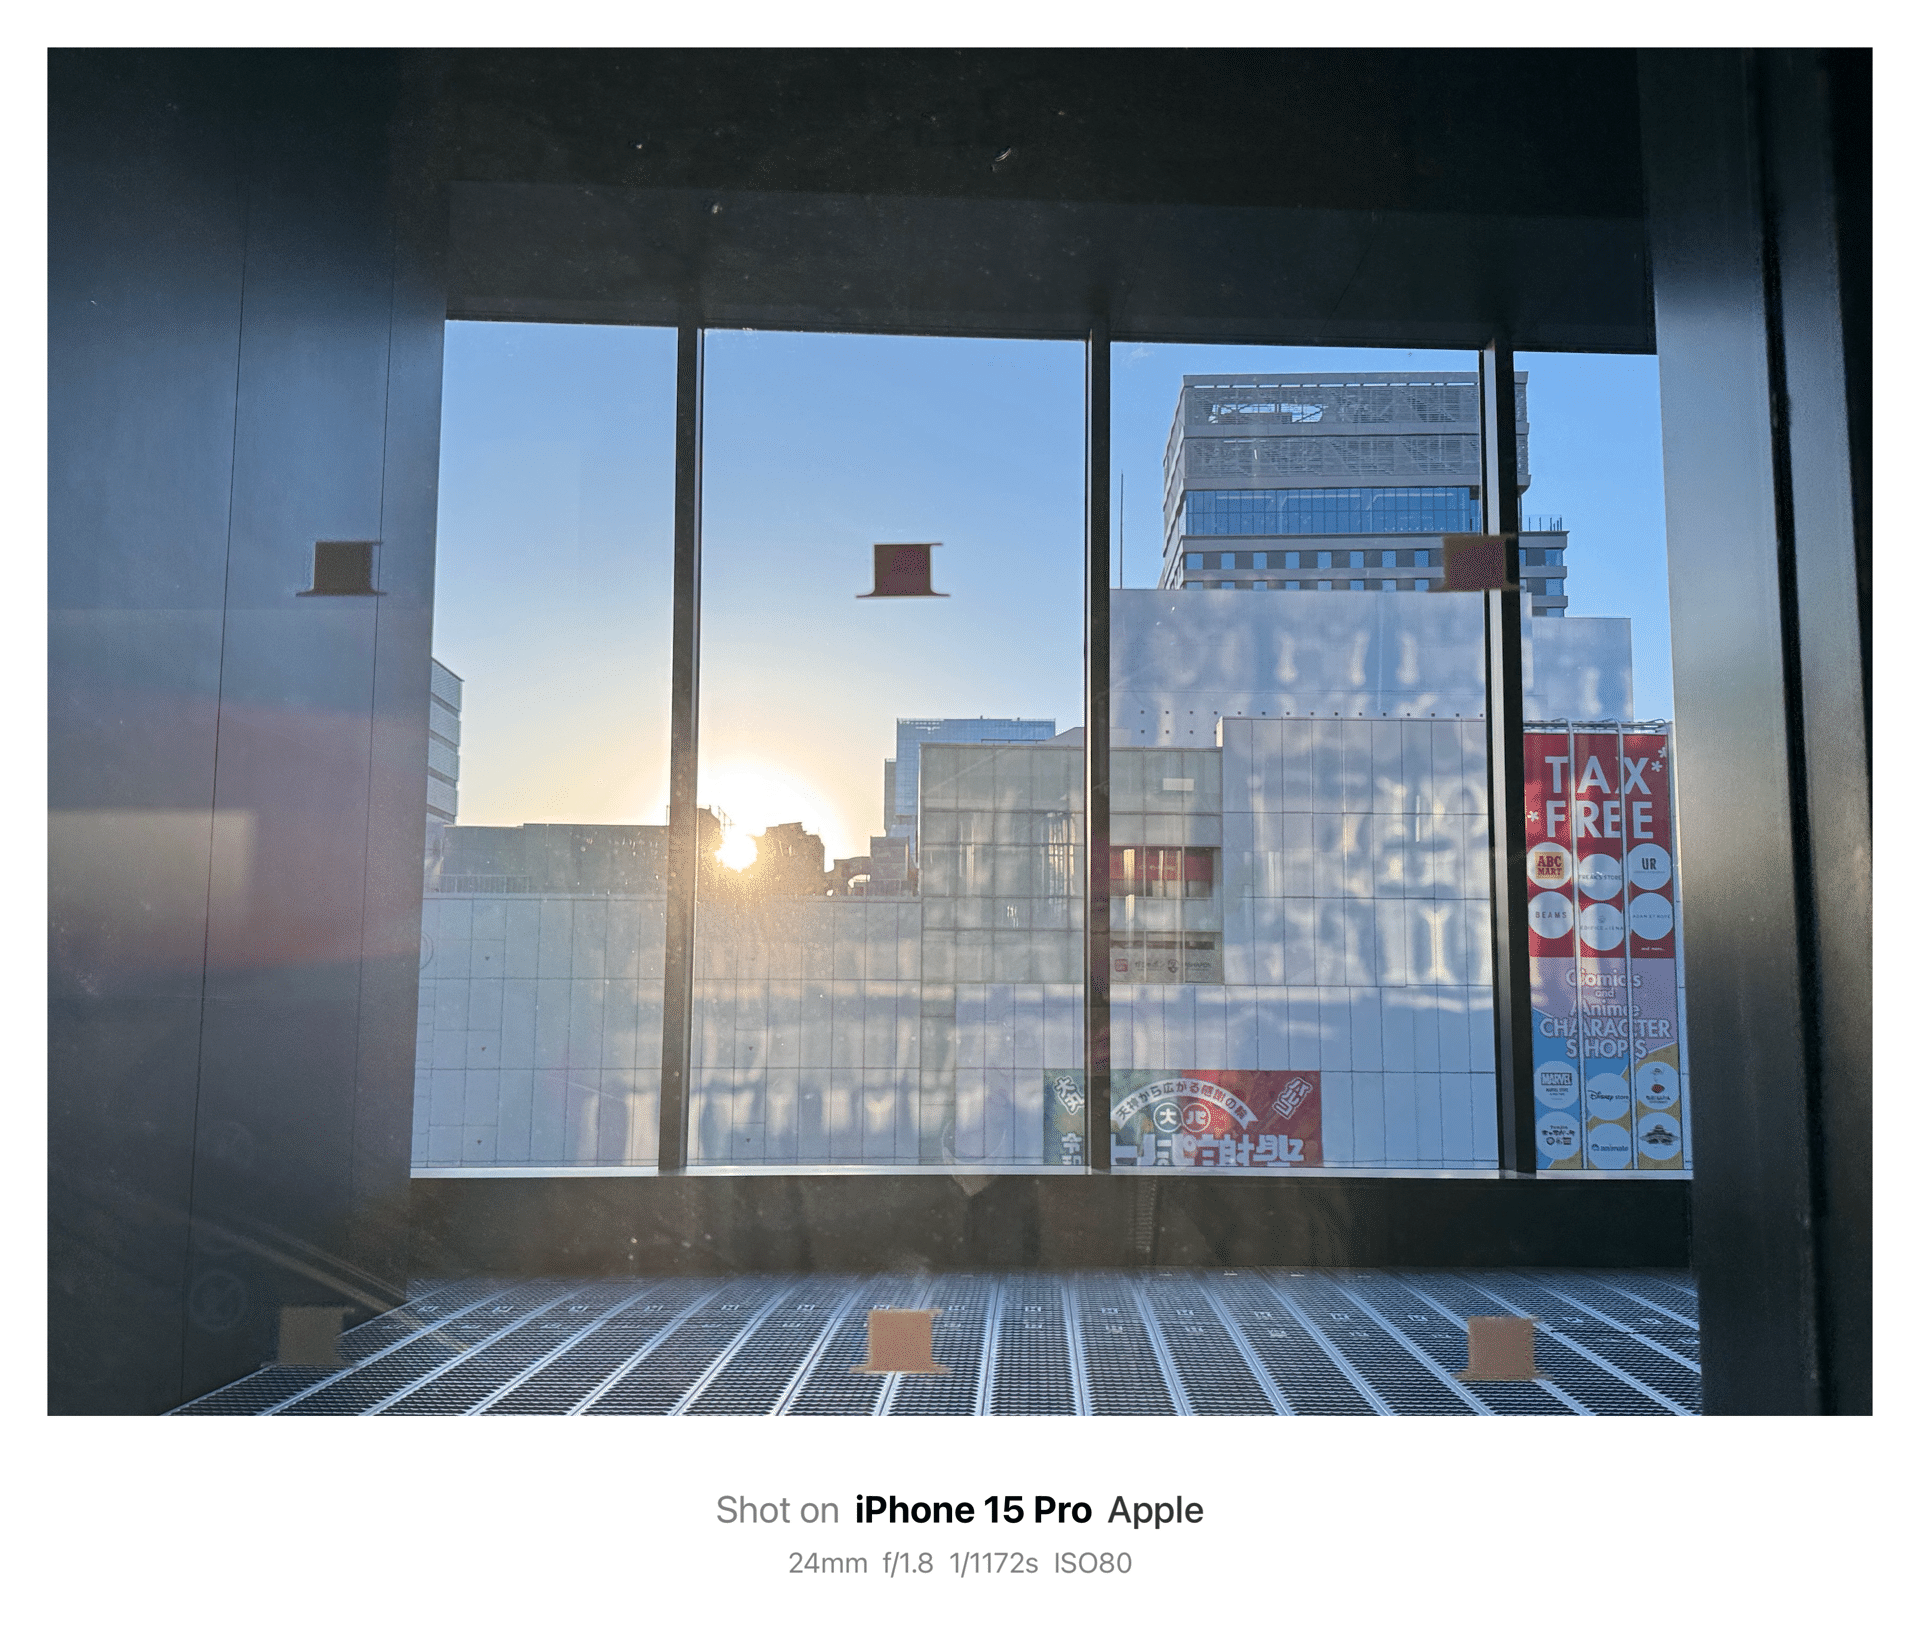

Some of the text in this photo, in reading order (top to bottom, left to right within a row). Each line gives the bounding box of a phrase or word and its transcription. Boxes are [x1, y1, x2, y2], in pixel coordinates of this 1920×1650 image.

[1545, 755, 1652, 795] TAX
[1546, 800, 1654, 839] FREE
[1537, 855, 1562, 867] ABC
[1641, 857, 1657, 870] UR
[1537, 867, 1562, 876] MART
[1535, 911, 1567, 919] BEAMS
[1566, 969, 1642, 987] Comics
[1594, 988, 1614, 998] and
[1570, 1000, 1640, 1017] Anime
[1539, 1018, 1672, 1038] CHARACTER
[1566, 1039, 1648, 1059] SHOPS
[1541, 1073, 1572, 1085] MARVEL
[1115, 1083, 1247, 1121] 天神から広がる感謝の輪
[1587, 1090, 1614, 1101] Disney
[1600, 1144, 1629, 1152] animate
